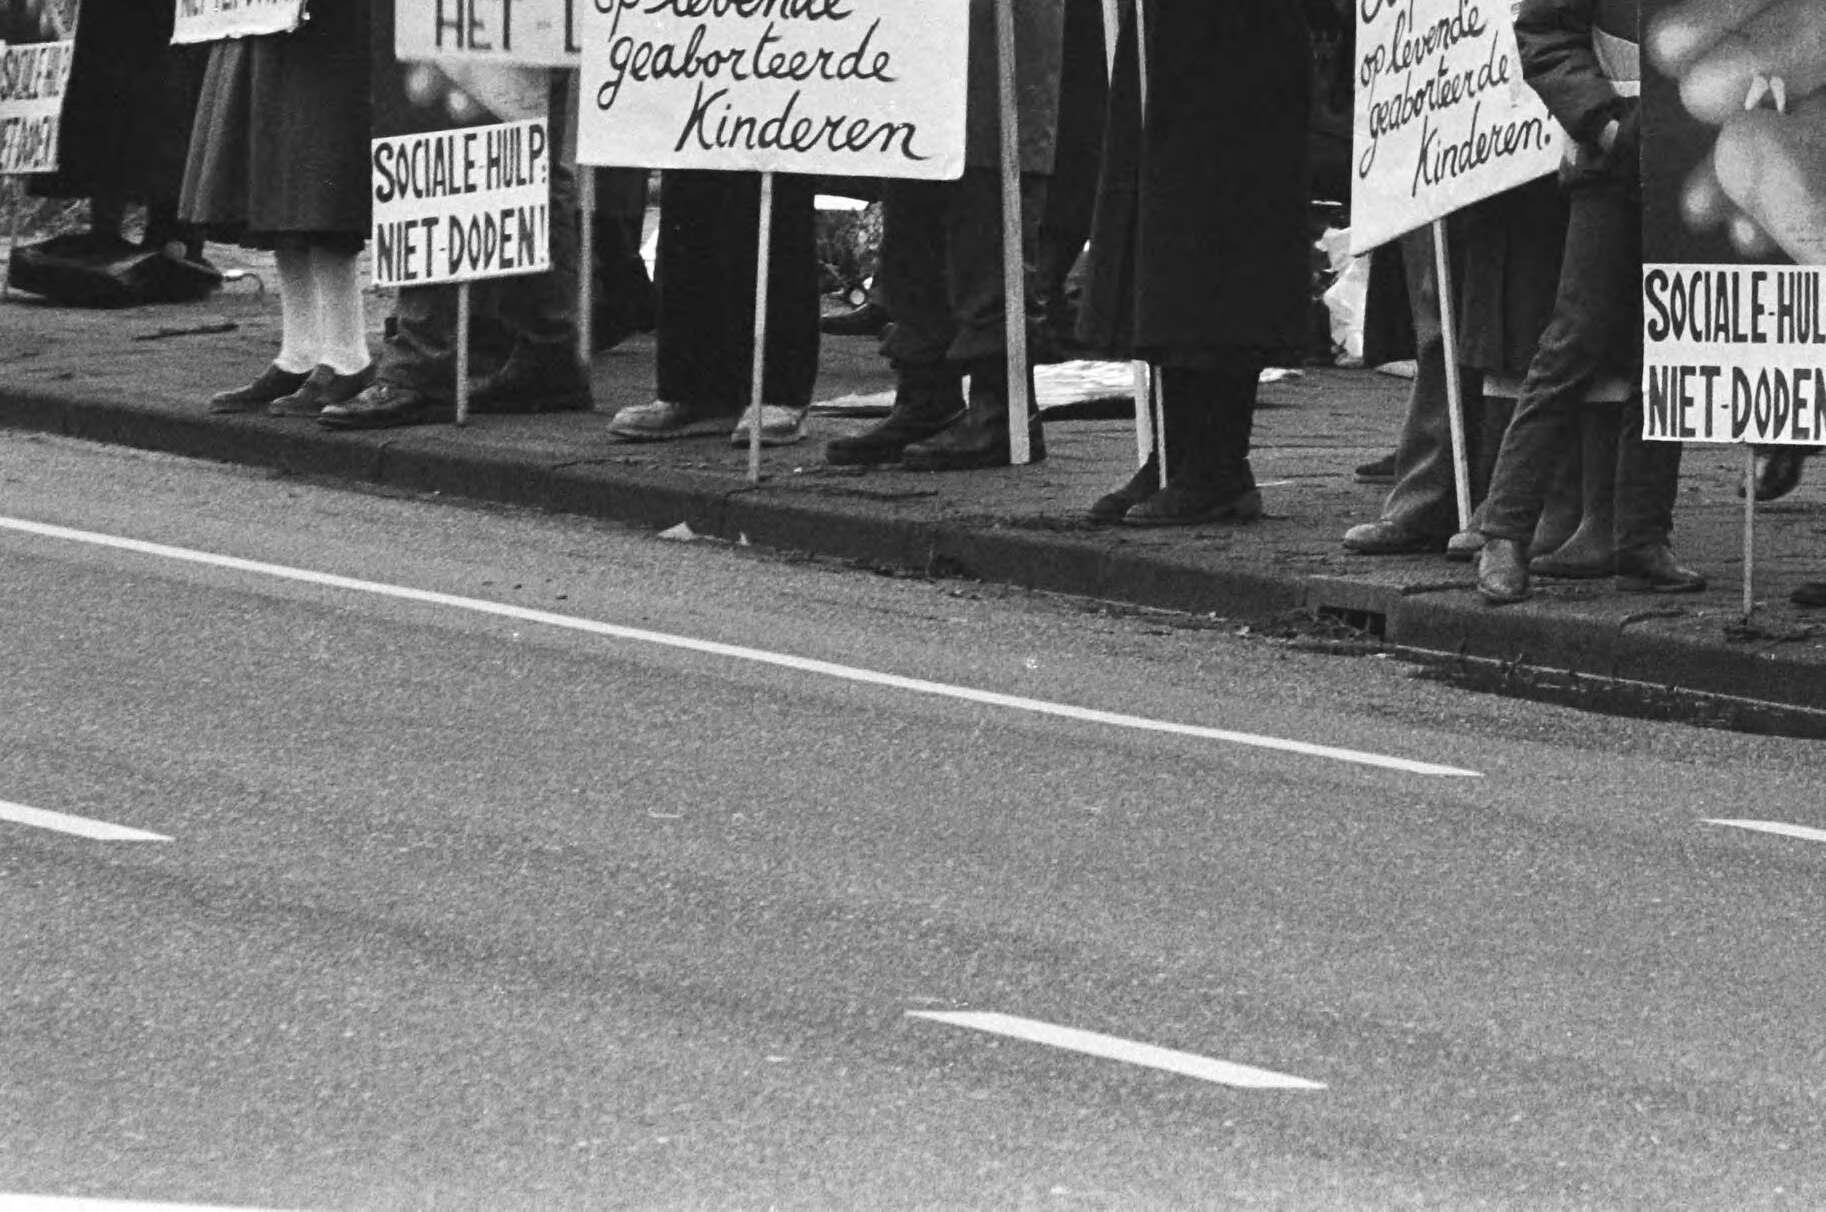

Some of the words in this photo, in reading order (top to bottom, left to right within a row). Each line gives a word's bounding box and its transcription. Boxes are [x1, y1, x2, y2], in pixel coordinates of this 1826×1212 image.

[596, 16, 901, 110] geaborteerde
[1358, 29, 1511, 180] geaborteerde
[1359, 44, 1387, 112] op
[674, 79, 934, 161] Kinderen
